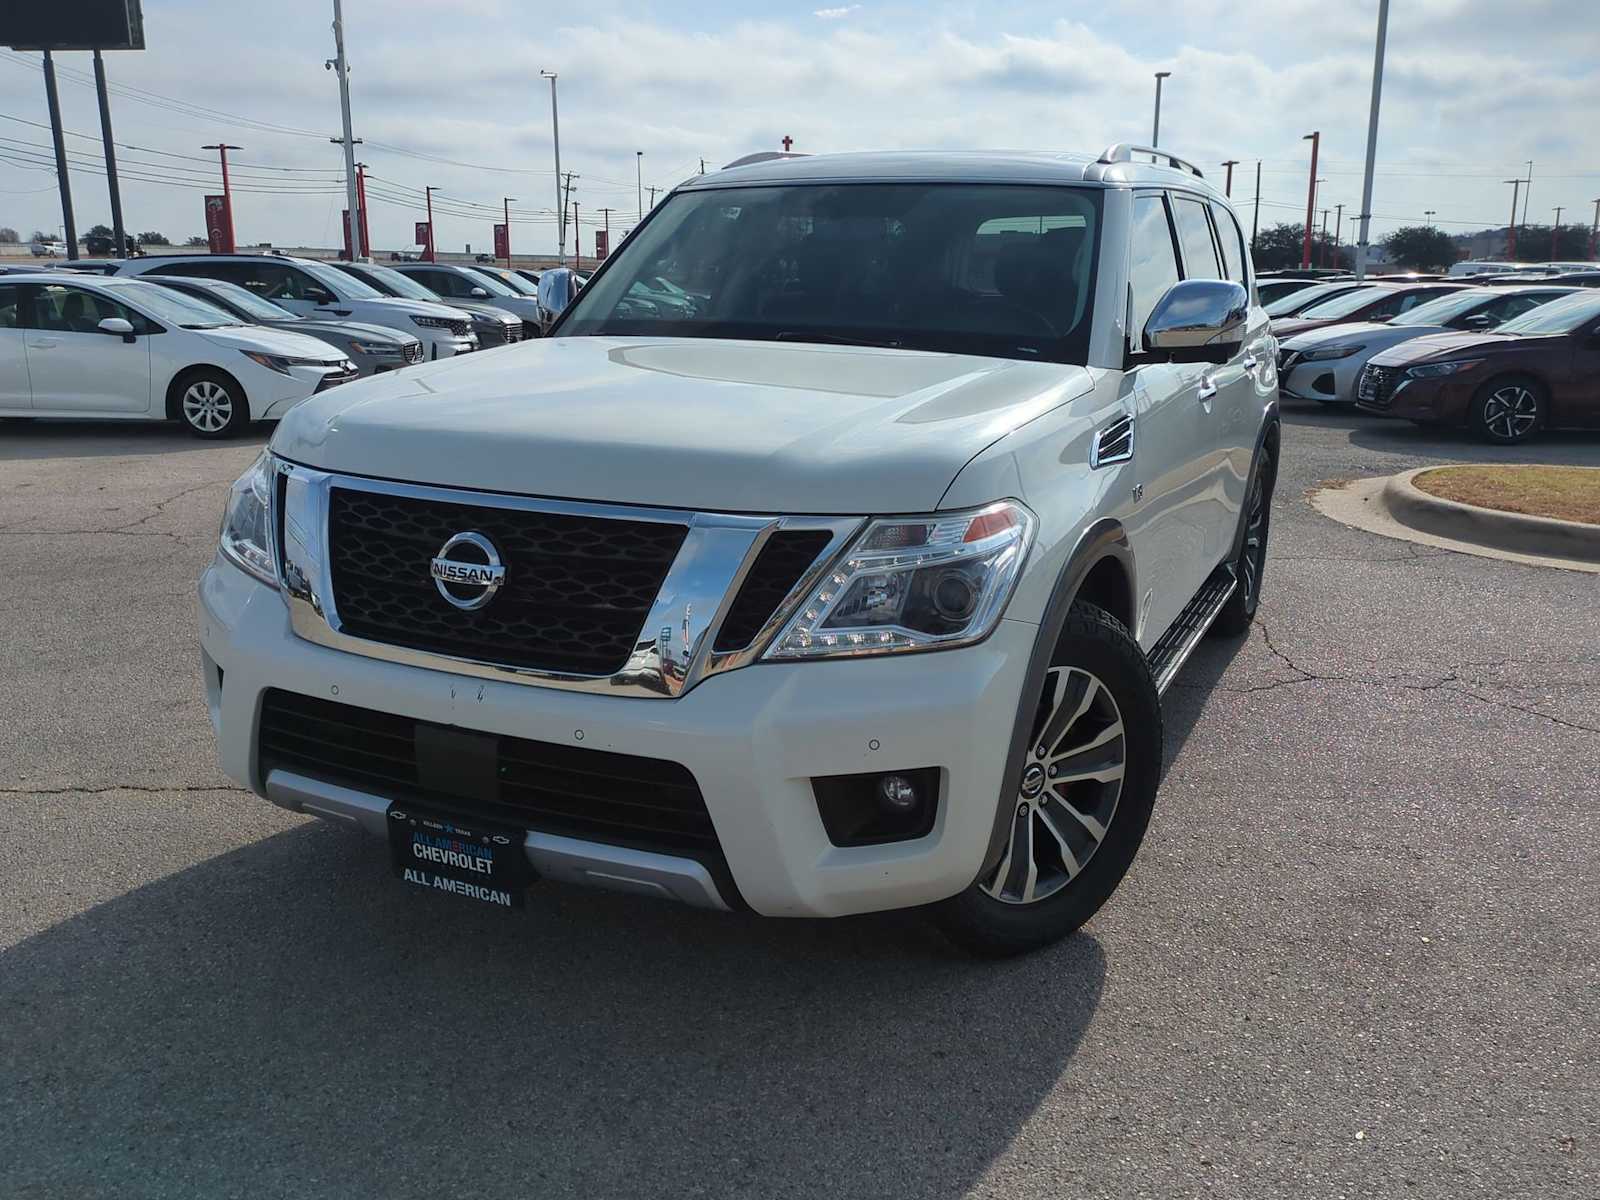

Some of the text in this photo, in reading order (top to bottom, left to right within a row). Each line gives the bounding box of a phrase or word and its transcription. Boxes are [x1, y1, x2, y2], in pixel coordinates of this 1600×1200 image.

[432, 562, 494, 582] NISSAN
[413, 832, 492, 859] ALL AMERICAN
[413, 843, 493, 875] CHEVROLET
[404, 868, 511, 906] ALL AMERICAN
